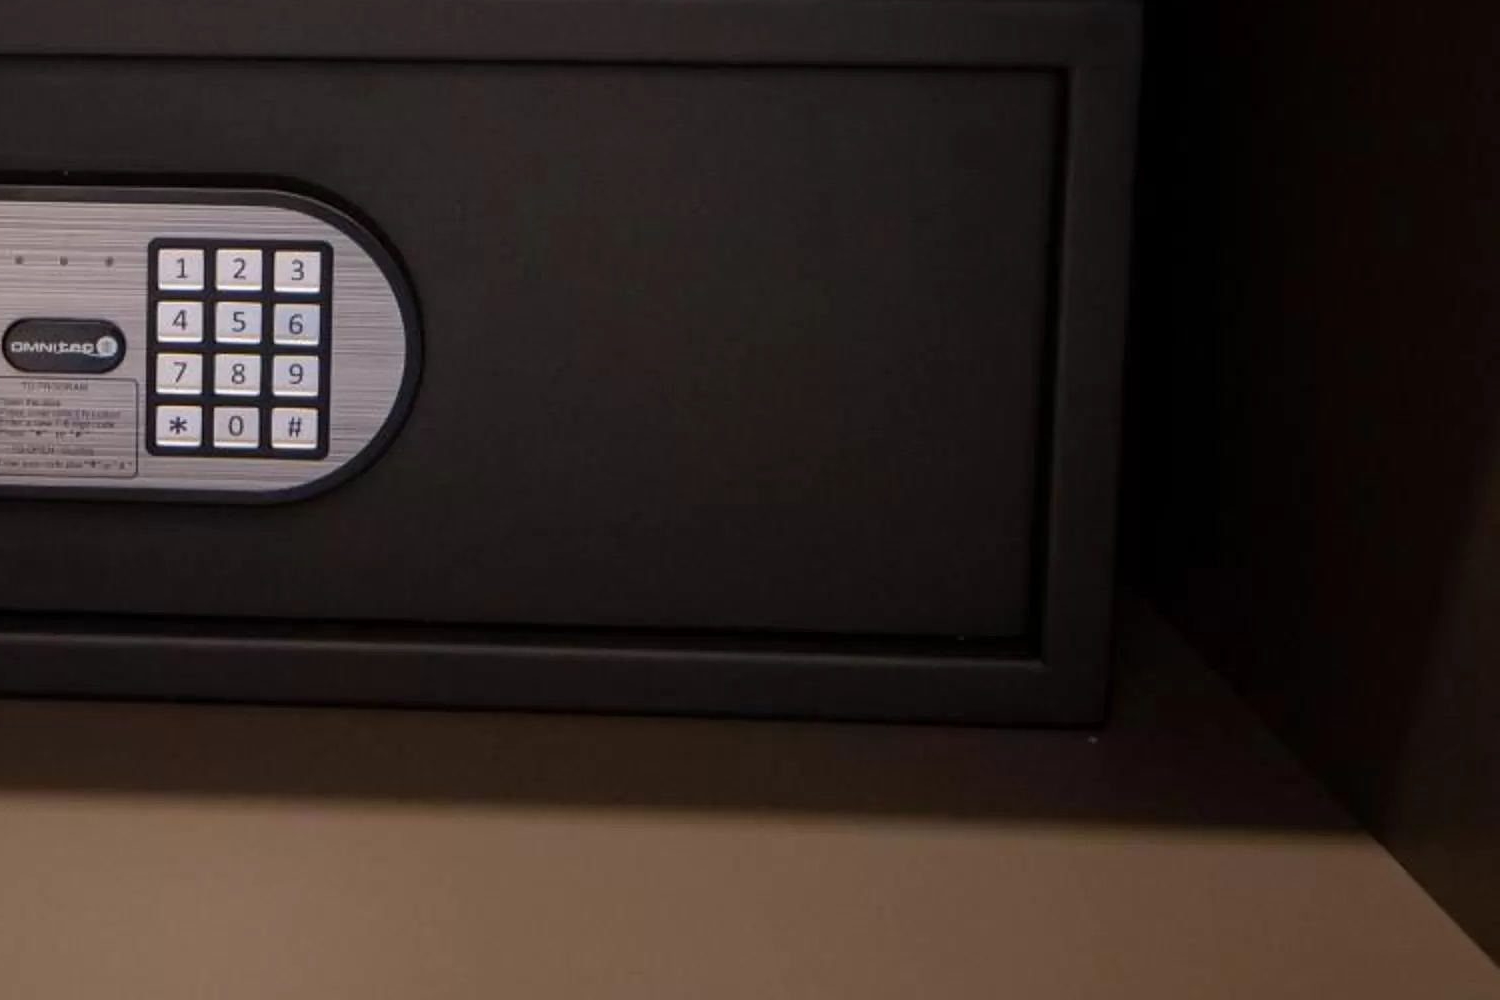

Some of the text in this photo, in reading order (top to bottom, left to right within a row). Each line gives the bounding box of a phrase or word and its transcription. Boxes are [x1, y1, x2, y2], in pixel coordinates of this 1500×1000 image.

[175, 257, 305, 281] 1 2 3
[172, 309, 304, 335] 4 5 6
[173, 361, 304, 385] 7 8 9
[228, 415, 245, 437] 0
[287, 417, 303, 438] #
